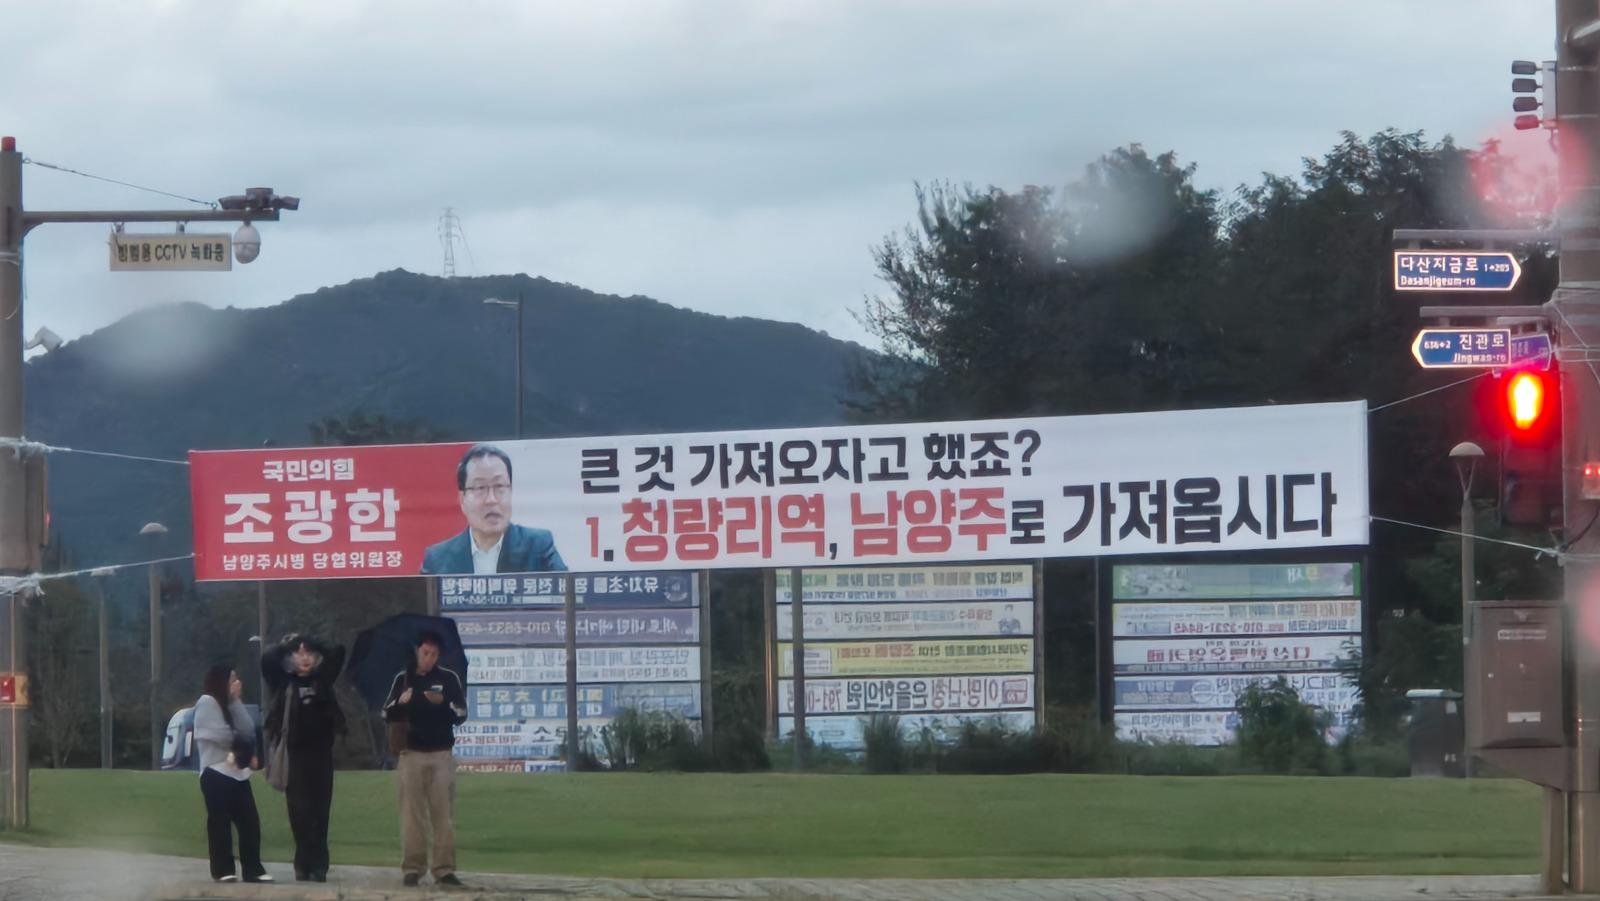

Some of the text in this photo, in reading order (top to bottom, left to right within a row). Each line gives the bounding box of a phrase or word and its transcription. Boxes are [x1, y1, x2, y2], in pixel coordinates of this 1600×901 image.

[118, 243, 224, 262] 방범용 CCTV 녹화중
[1400, 256, 1479, 274] 다산지금로
[1400, 275, 1476, 287] Dasanjigeum-ro
[1459, 333, 1505, 350] 진관로
[1453, 353, 1507, 364] Jingwan-ro
[262, 458, 355, 482] 국민의힘
[580, 428, 1042, 494] 큰 것 가져오자고 했죠?
[223, 488, 401, 544] 조광한
[585, 471, 1338, 562] 1. 청량리역, 남양주로 가져옵시다
[223, 550, 403, 571] 남양주시병 당협위원장
